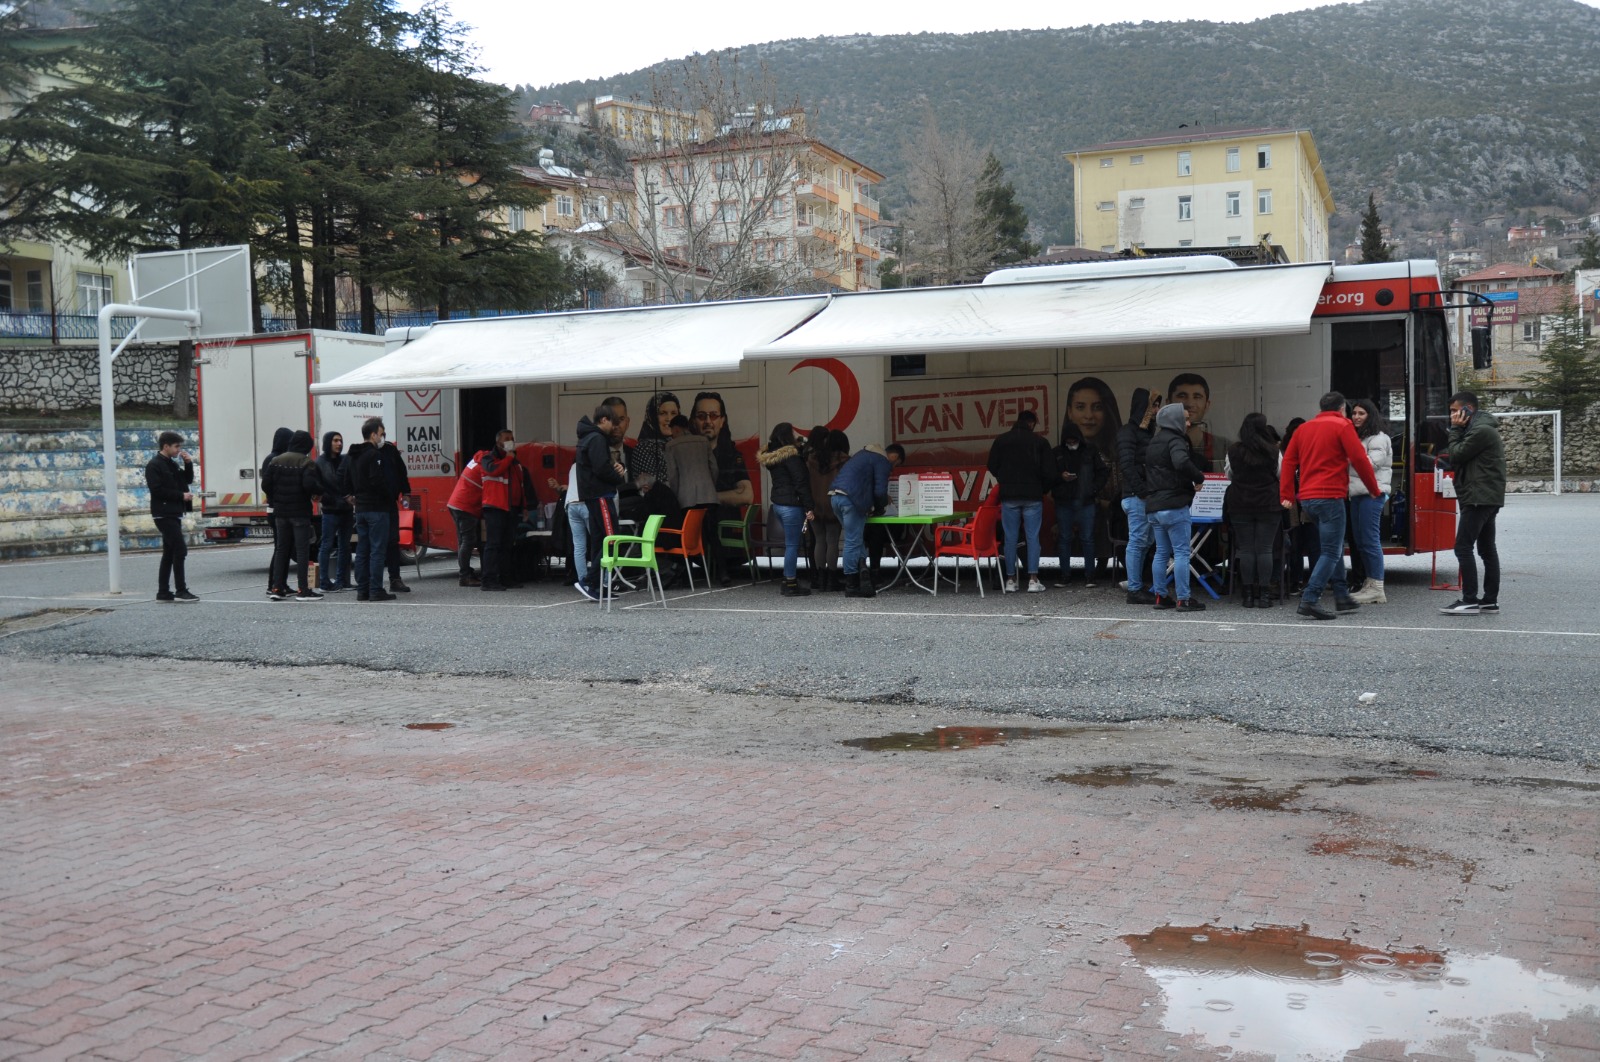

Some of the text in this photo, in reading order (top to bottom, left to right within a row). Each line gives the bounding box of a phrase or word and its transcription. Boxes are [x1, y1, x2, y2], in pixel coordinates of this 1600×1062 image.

[1473, 306, 1487, 316] GÜL
[348, 400, 368, 410] BAĞIŞI
[370, 401, 383, 409] EKİP
[897, 396, 1040, 434] KAN VER
[407, 426, 440, 441] KAN
[407, 441, 440, 454] BAĞIŞI
[407, 454, 440, 463] HAYAT
